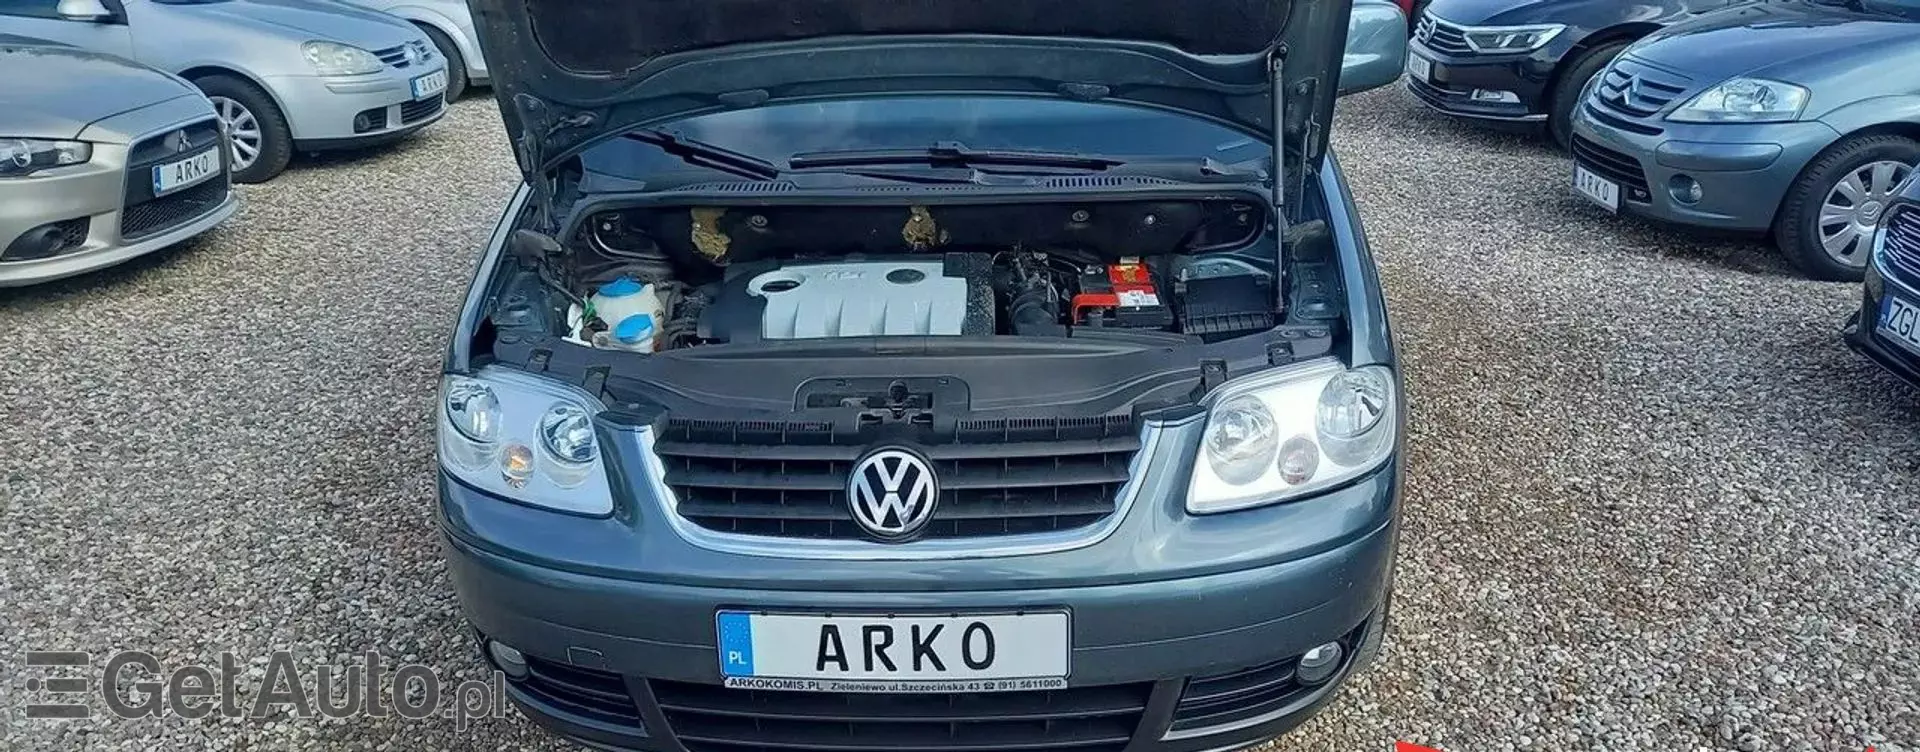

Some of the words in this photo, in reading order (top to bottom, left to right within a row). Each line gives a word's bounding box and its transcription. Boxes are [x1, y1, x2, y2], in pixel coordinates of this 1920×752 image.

[175, 154, 208, 183] ARKO
[1580, 171, 1609, 201] ARKO
[728, 651, 747, 665] PL
[816, 621, 996, 672] ARKO
[729, 678, 823, 691] ARKOKOMIS.PL
[967, 682, 980, 691] 43
[998, 681, 1016, 690] (91)
[1019, 679, 1062, 689] 5611000
